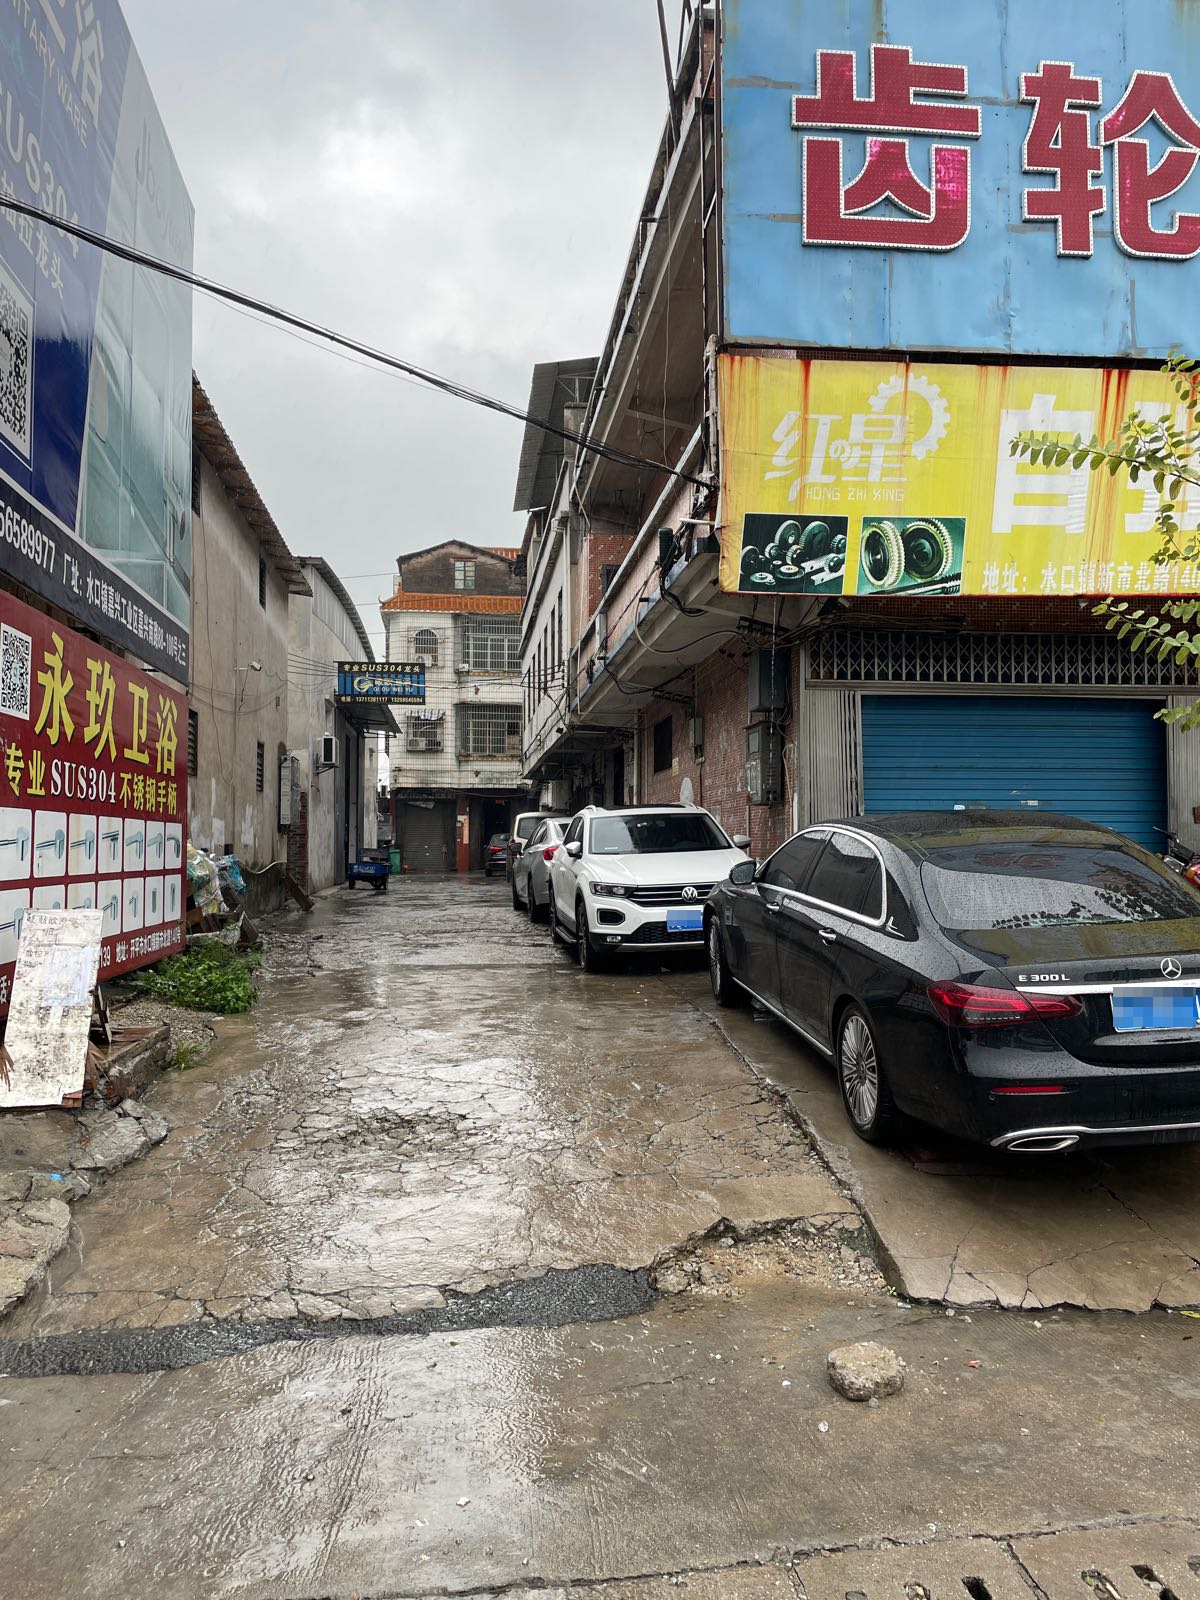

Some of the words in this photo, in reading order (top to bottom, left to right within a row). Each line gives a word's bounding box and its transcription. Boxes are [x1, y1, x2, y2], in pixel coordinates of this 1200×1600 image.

[0, 80, 79, 259] US304
[57, 69, 88, 149] WARE
[791, 42, 1200, 260] 齿轮
[806, 487, 841, 502] HONG
[872, 487, 905, 502] XING
[34, 631, 179, 777] 永玖卫浴
